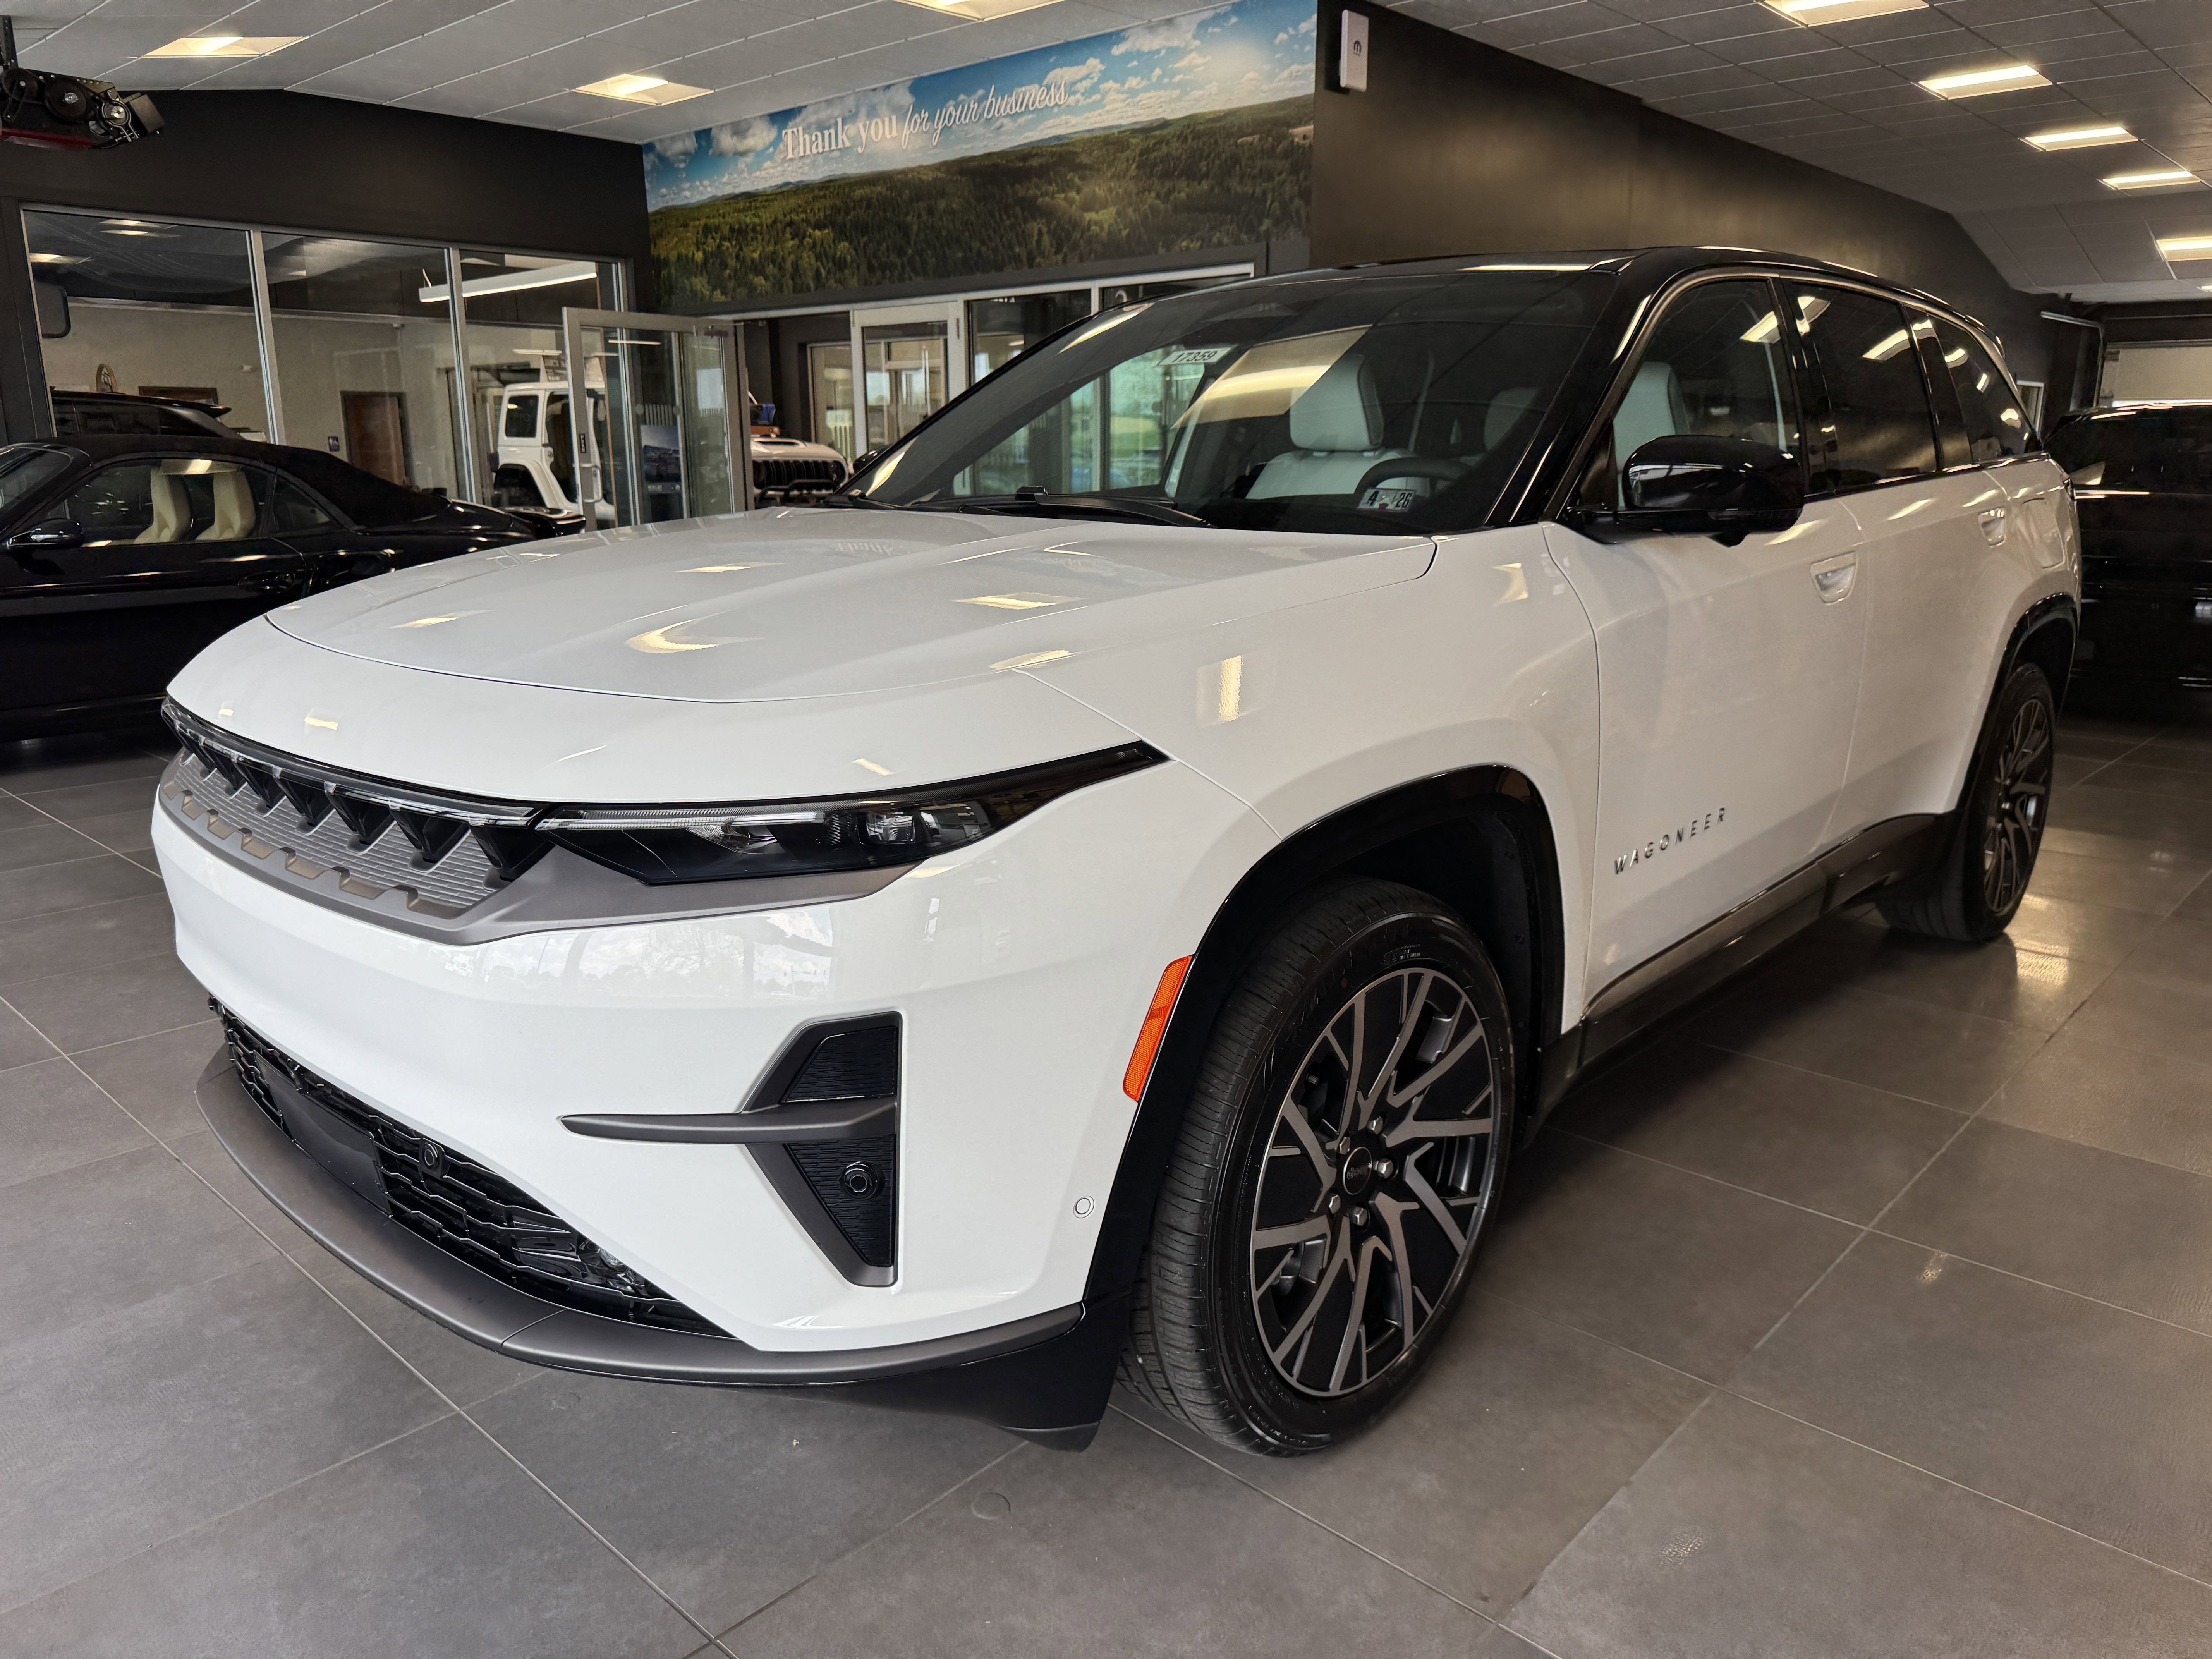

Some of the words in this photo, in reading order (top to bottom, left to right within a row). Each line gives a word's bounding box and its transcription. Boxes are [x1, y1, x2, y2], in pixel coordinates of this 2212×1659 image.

[782, 117, 851, 160] Thank
[857, 115, 898, 153] you
[902, 104, 930, 149] for
[932, 100, 981, 146] your
[984, 84, 1068, 120] business
[1172, 350, 1218, 363] 17359
[1366, 490, 1380, 506] 4
[1395, 492, 1413, 508] 26
[1613, 807, 1725, 875] WAGONEER
